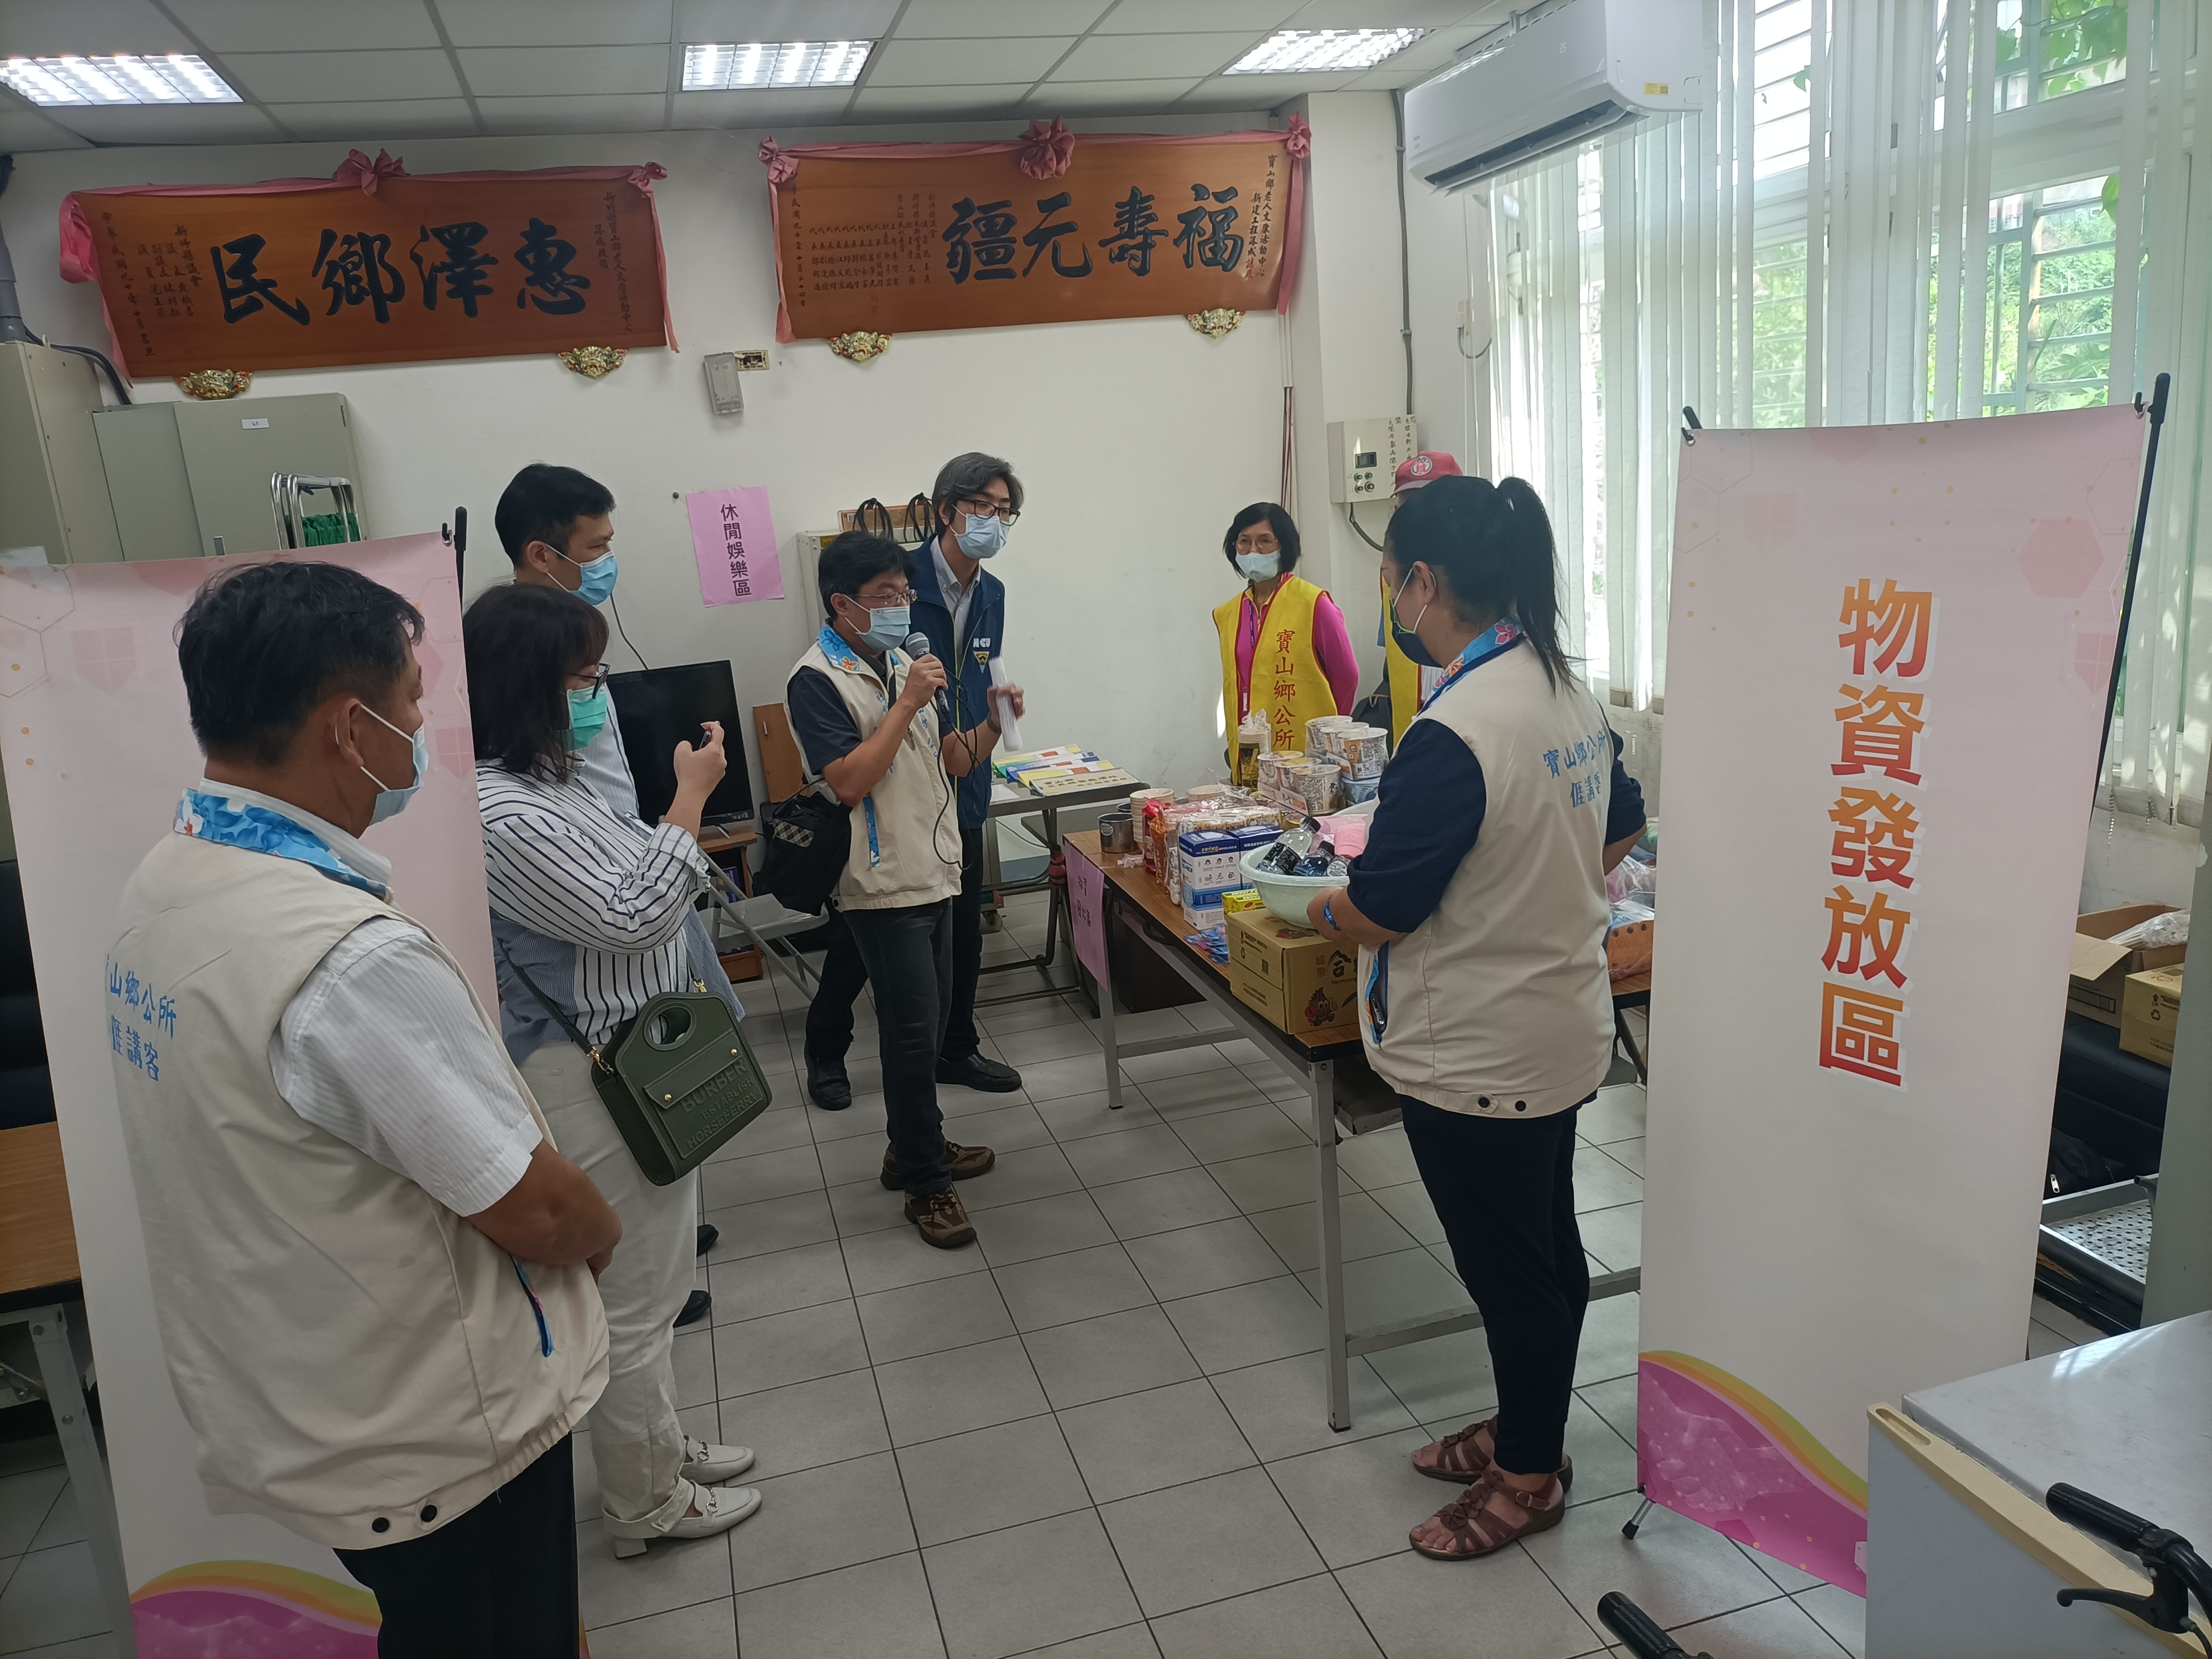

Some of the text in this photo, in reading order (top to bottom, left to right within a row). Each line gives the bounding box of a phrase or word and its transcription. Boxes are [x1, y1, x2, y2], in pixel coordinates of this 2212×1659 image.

[720, 503, 752, 597] 休閒娛樂區
[1272, 629, 1296, 751] 寶山鄉公所
[1818, 578, 1934, 1087] 物資發放區
[106, 954, 176, 1040] 山鄉公所
